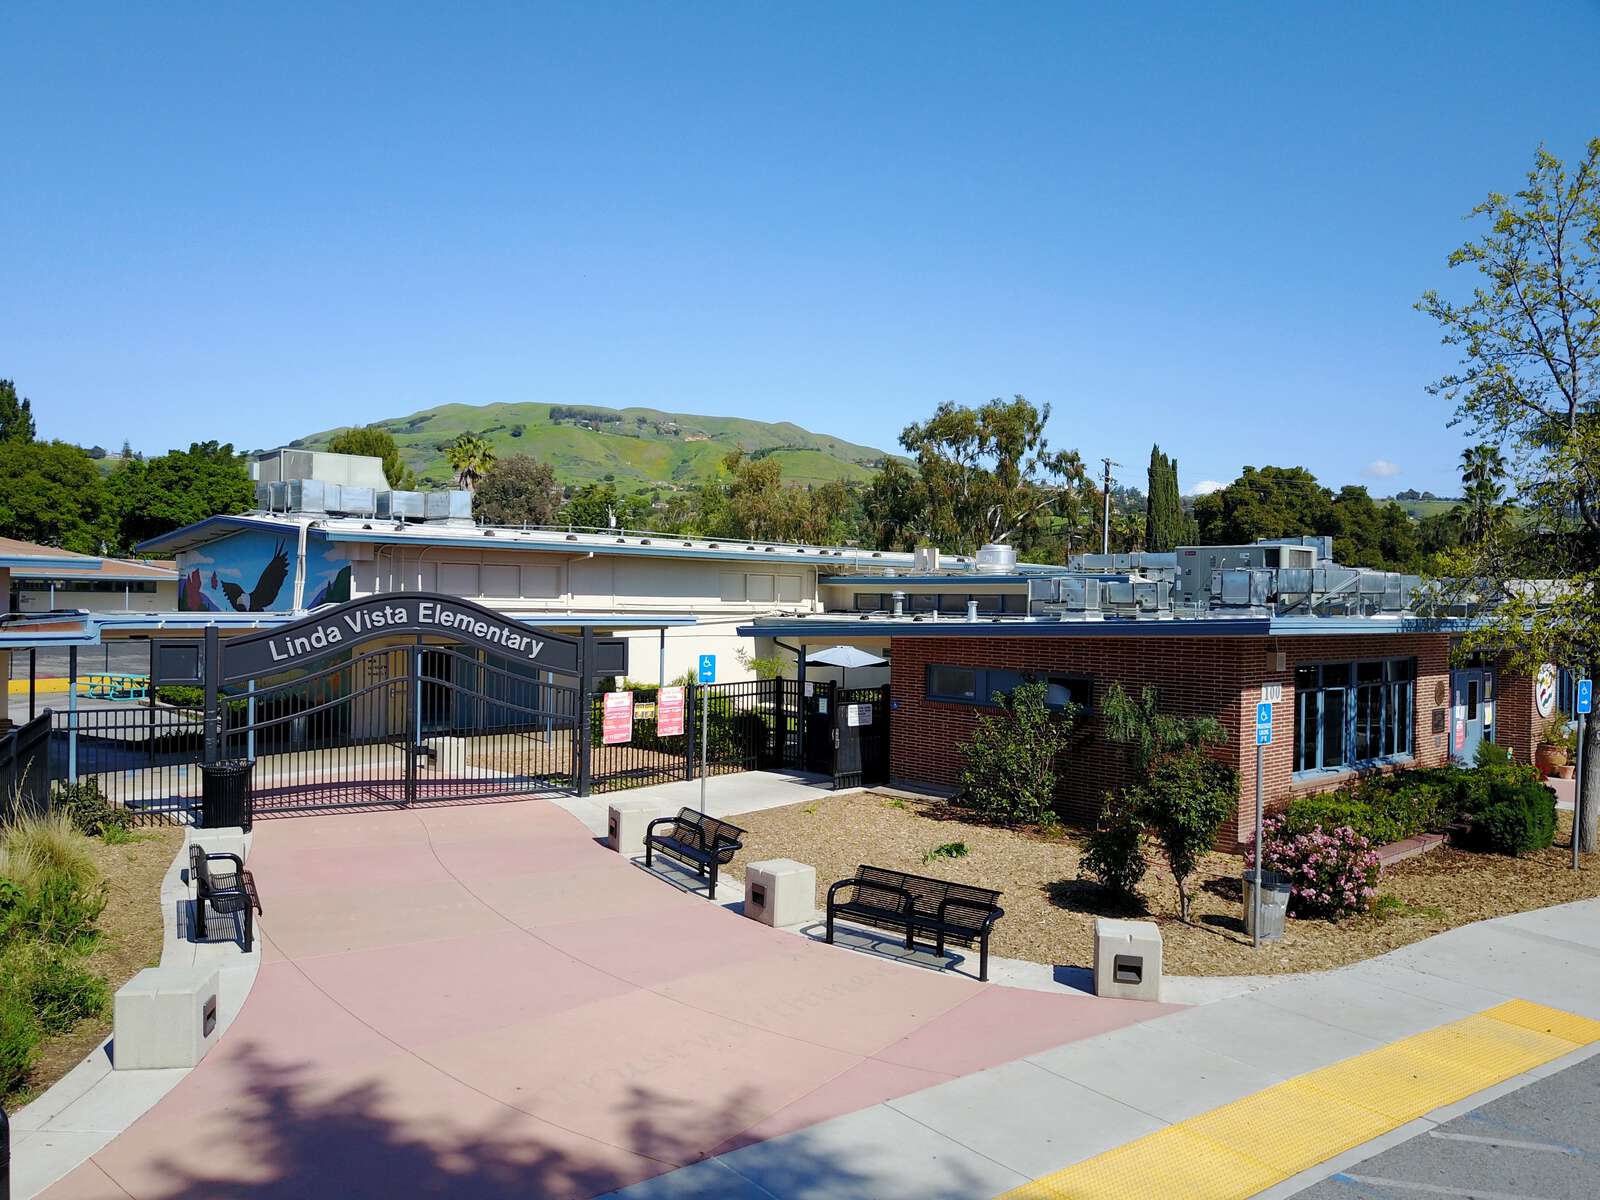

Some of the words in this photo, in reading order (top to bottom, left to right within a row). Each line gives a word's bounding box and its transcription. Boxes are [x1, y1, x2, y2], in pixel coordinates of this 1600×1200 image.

[269, 625, 342, 662] Linda
[344, 605, 408, 634] Vista
[418, 602, 544, 659] Elementary
[1264, 685, 1280, 700] 100
